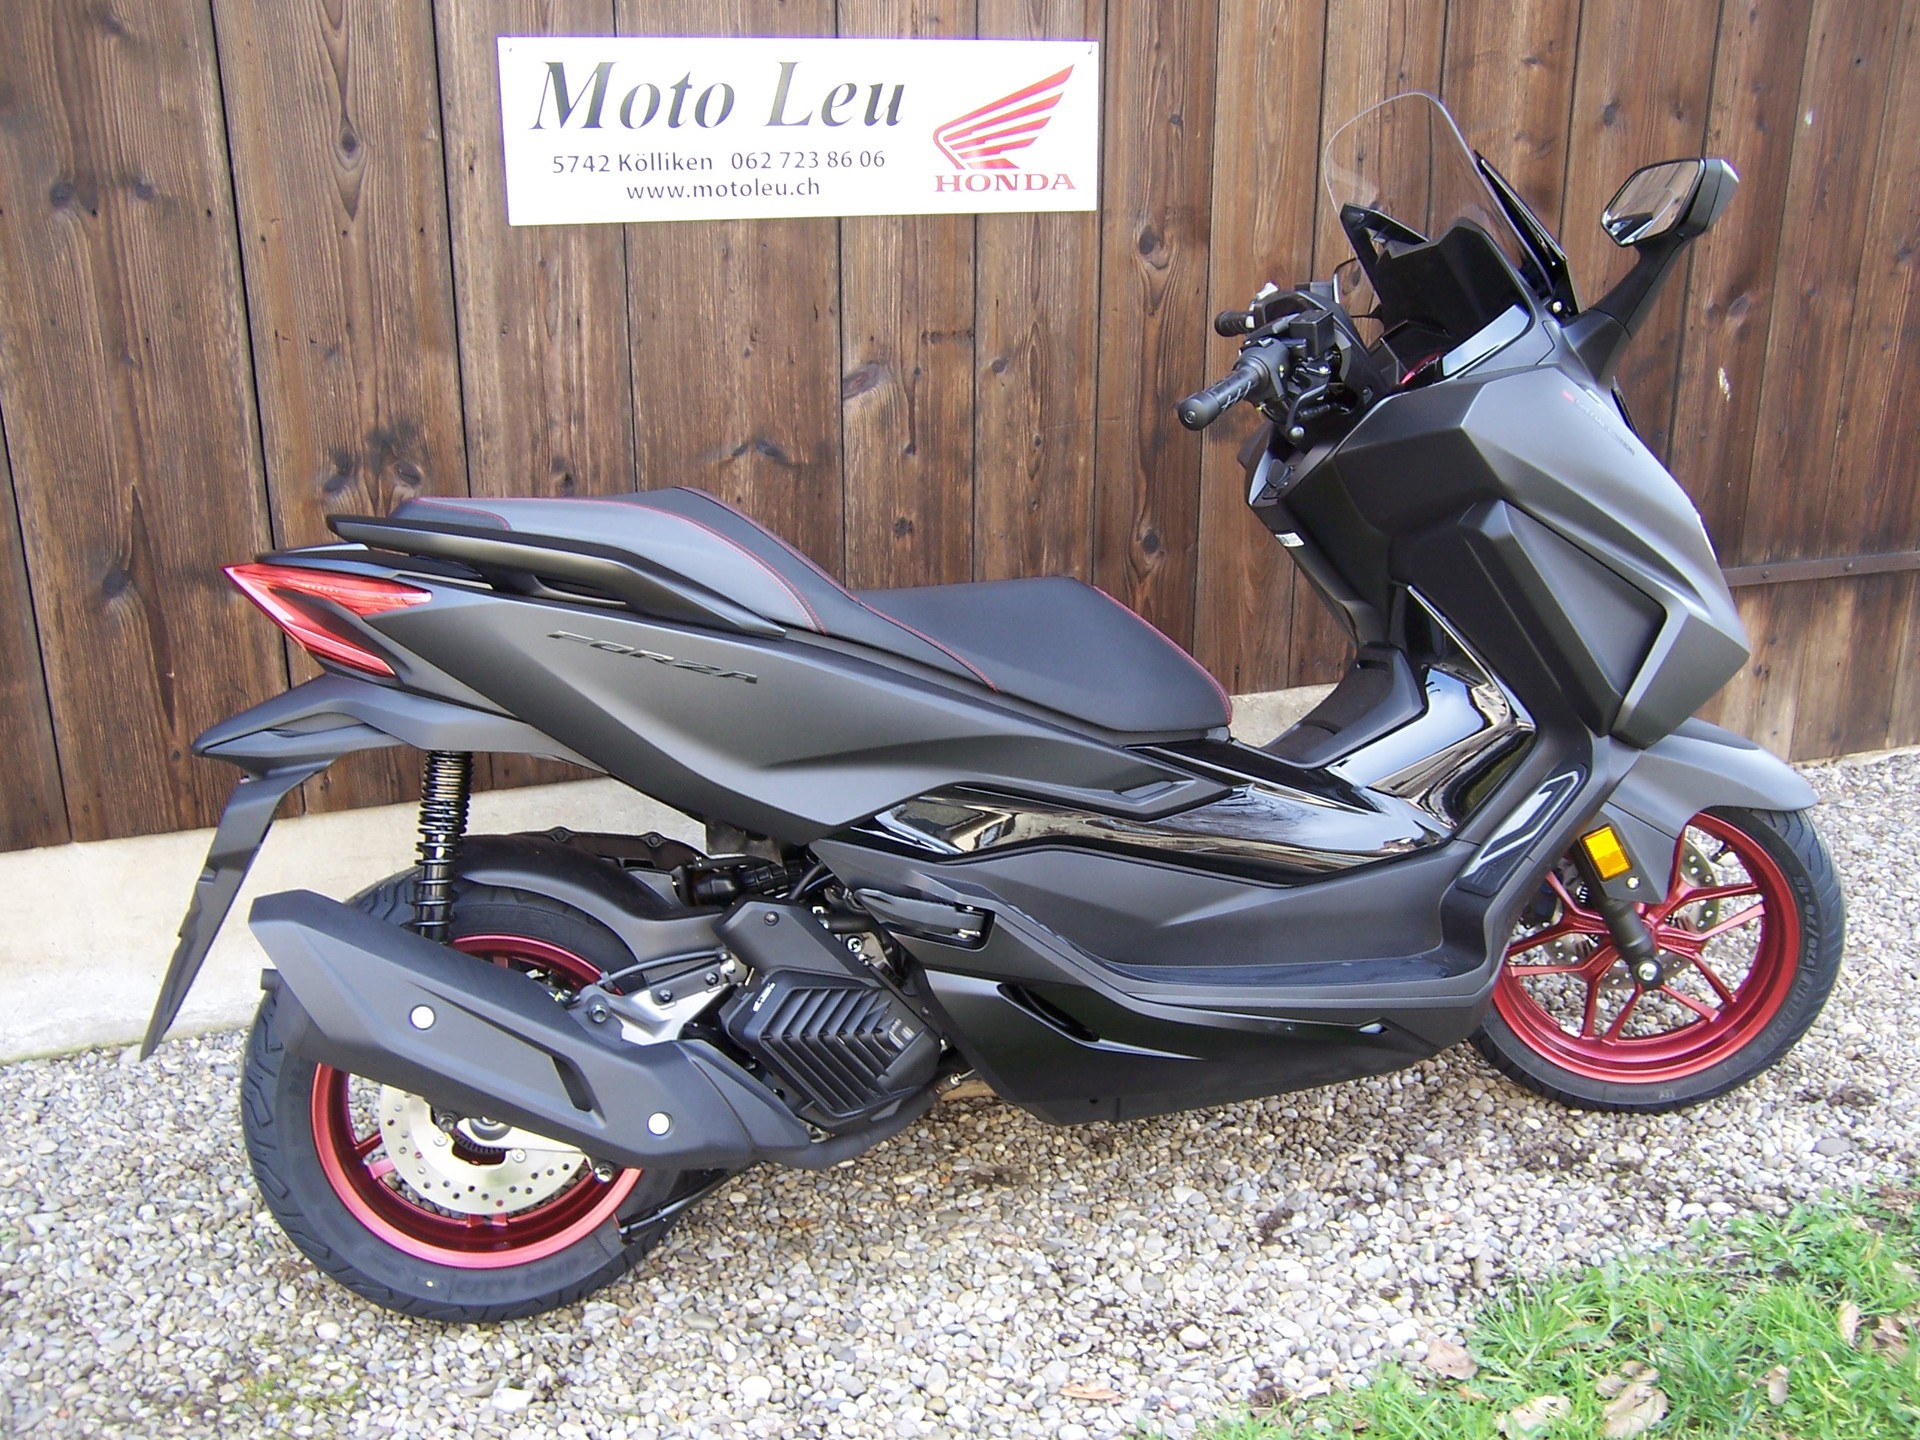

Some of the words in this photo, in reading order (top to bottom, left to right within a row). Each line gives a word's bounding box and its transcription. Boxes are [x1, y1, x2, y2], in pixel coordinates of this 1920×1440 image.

[530, 61, 734, 130] Moto
[765, 61, 905, 128] Leu
[553, 154, 611, 174] 5742
[618, 151, 713, 173] Kölliken
[731, 151, 772, 170] 062
[780, 151, 819, 169] 723
[827, 150, 853, 169] 86
[860, 150, 885, 168] 06
[626, 176, 820, 200] www.motoleu.ch
[935, 173, 1077, 193] HONDA
[547, 629, 758, 685] FORZA
